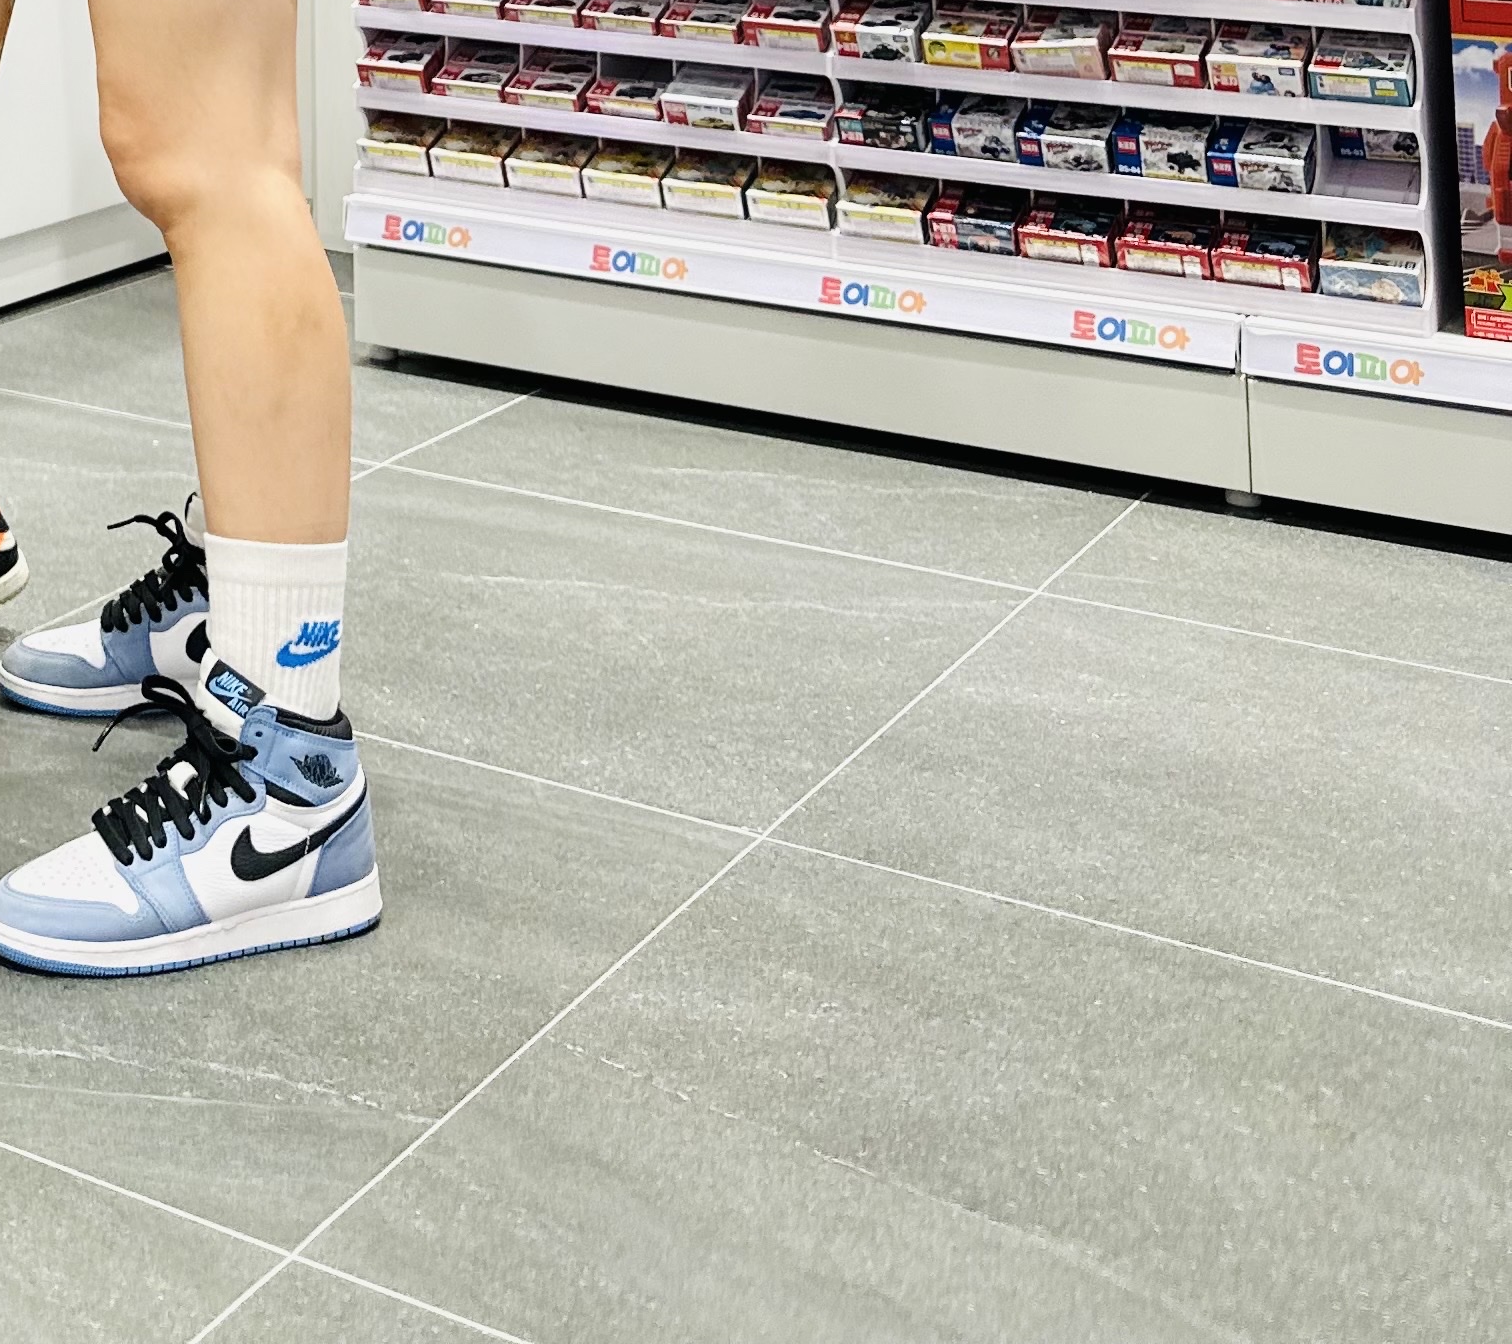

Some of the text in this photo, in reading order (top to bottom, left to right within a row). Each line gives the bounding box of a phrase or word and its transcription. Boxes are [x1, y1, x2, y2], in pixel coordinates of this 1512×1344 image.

[381, 214, 472, 249] 토이피아
[590, 244, 689, 282] 토이피아
[819, 276, 927, 315] 토이피아
[1070, 310, 1191, 352] 토이피아
[1294, 343, 1425, 386] 토이피아
[295, 620, 341, 647] NIKE
[217, 670, 252, 698] NIKE
[227, 696, 251, 717] AIR
